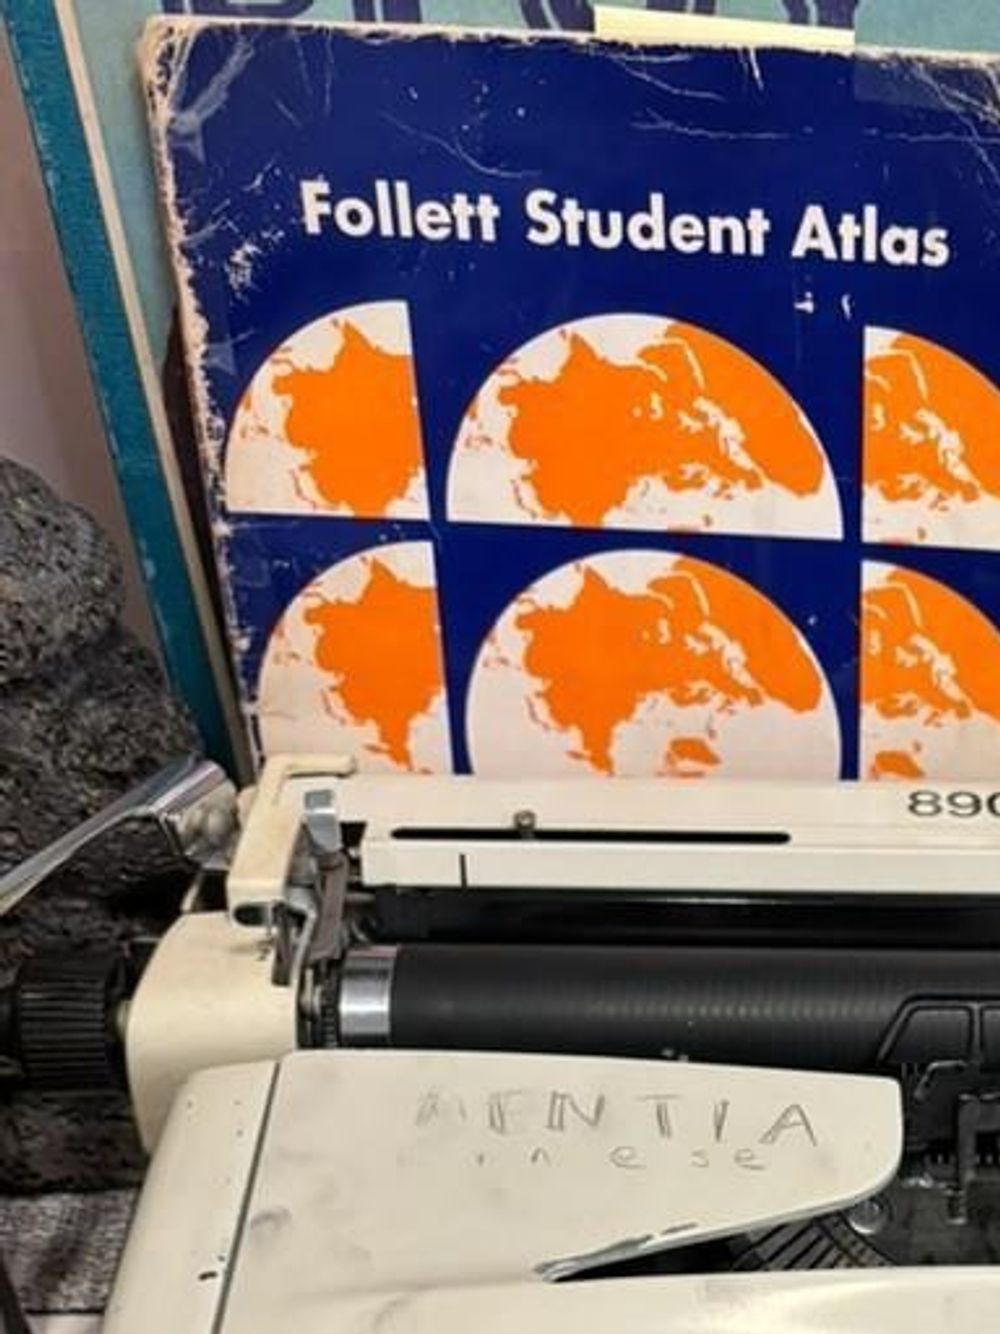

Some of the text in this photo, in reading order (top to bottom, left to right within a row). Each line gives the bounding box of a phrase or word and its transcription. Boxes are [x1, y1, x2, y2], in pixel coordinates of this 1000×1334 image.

[300, 177, 950, 267] Follett Student Atlas
